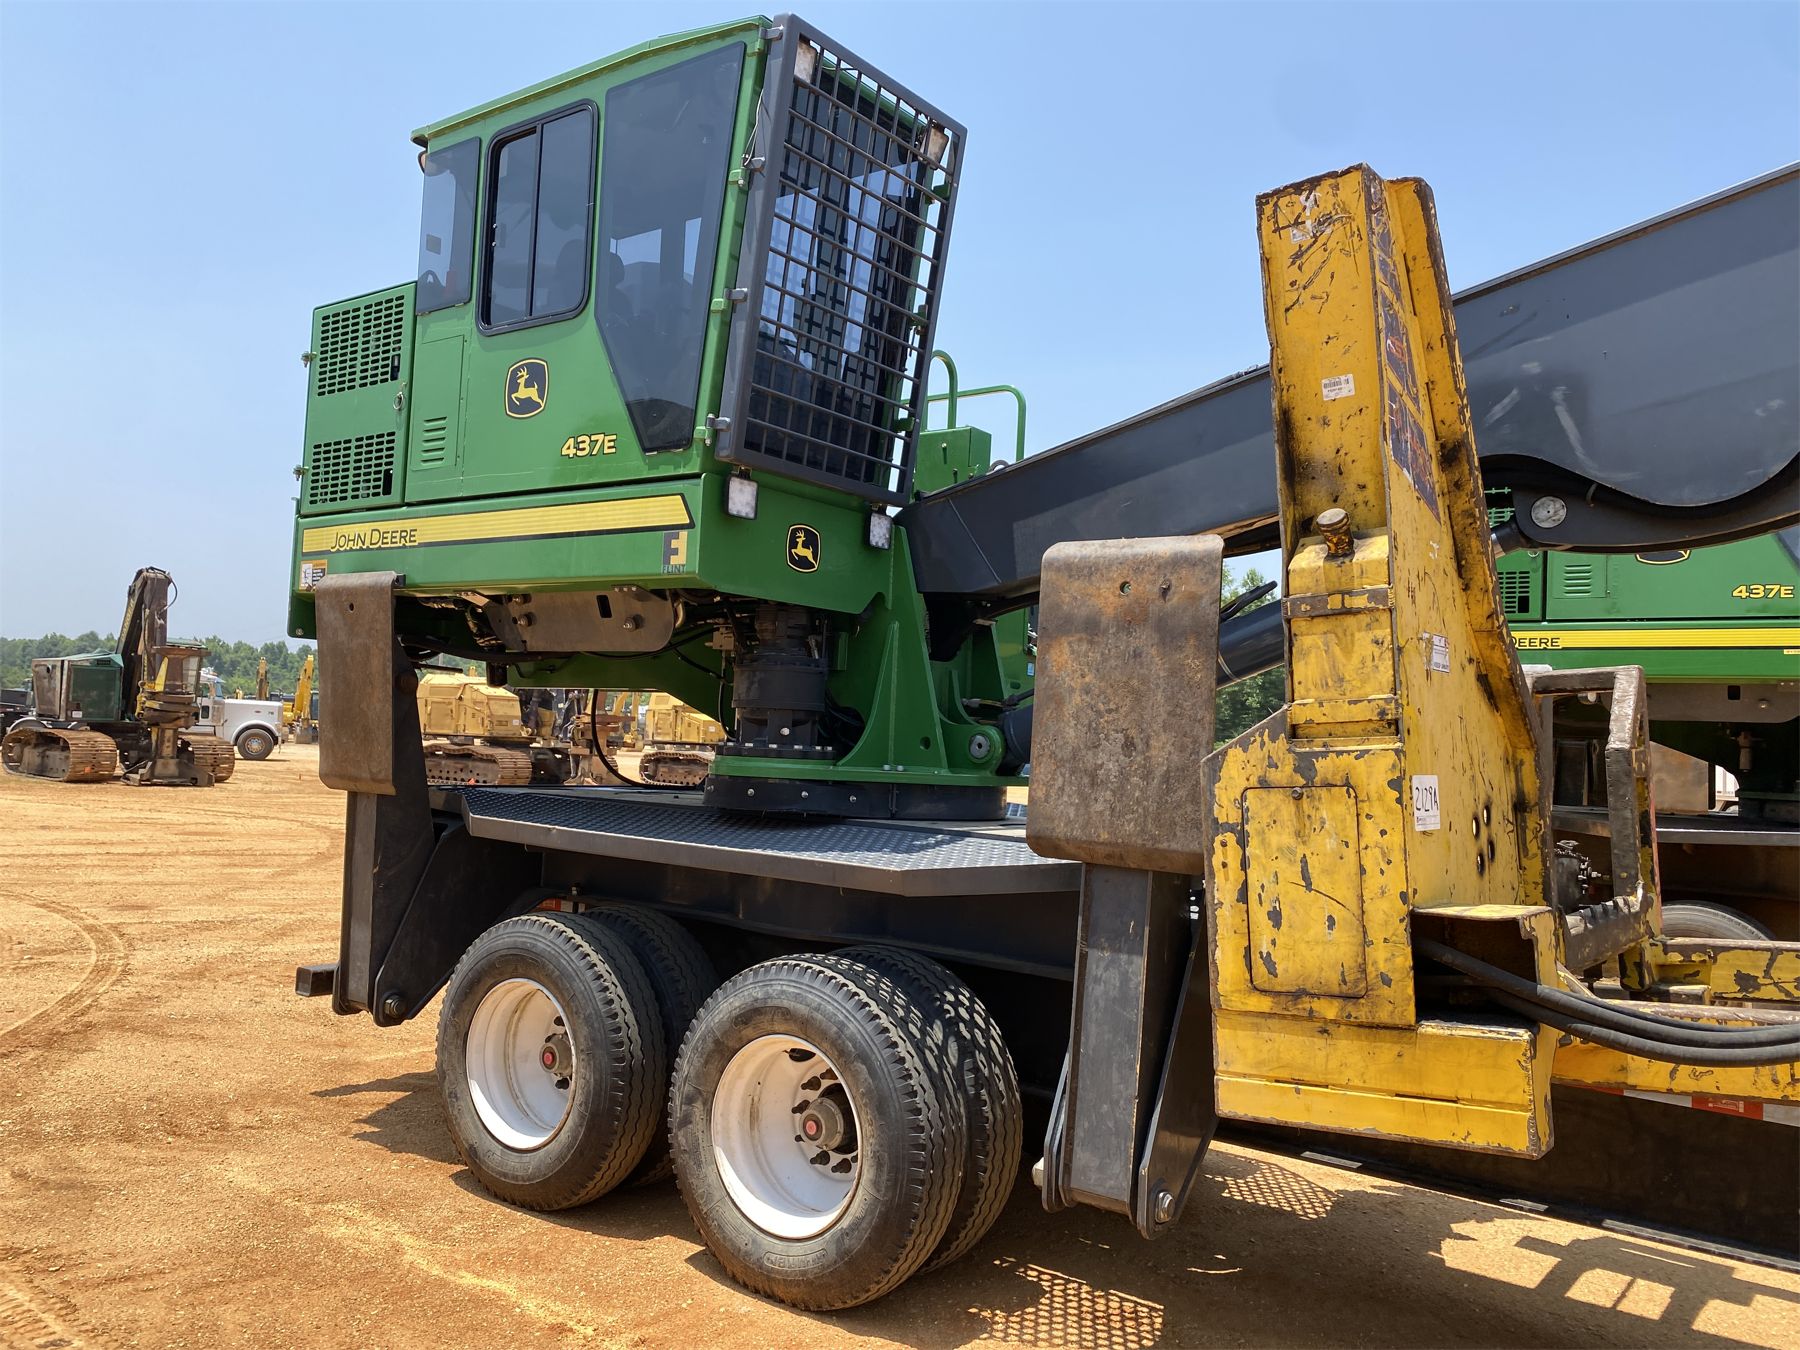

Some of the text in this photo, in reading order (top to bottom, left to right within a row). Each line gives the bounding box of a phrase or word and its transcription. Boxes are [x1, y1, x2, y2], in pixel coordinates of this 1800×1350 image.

[561, 432, 617, 458] 437E
[330, 528, 418, 550] JOHN DEERE
[662, 564, 686, 574] FLINT
[1732, 583, 1794, 599] 437E
[1415, 785, 1439, 812] 2129A
